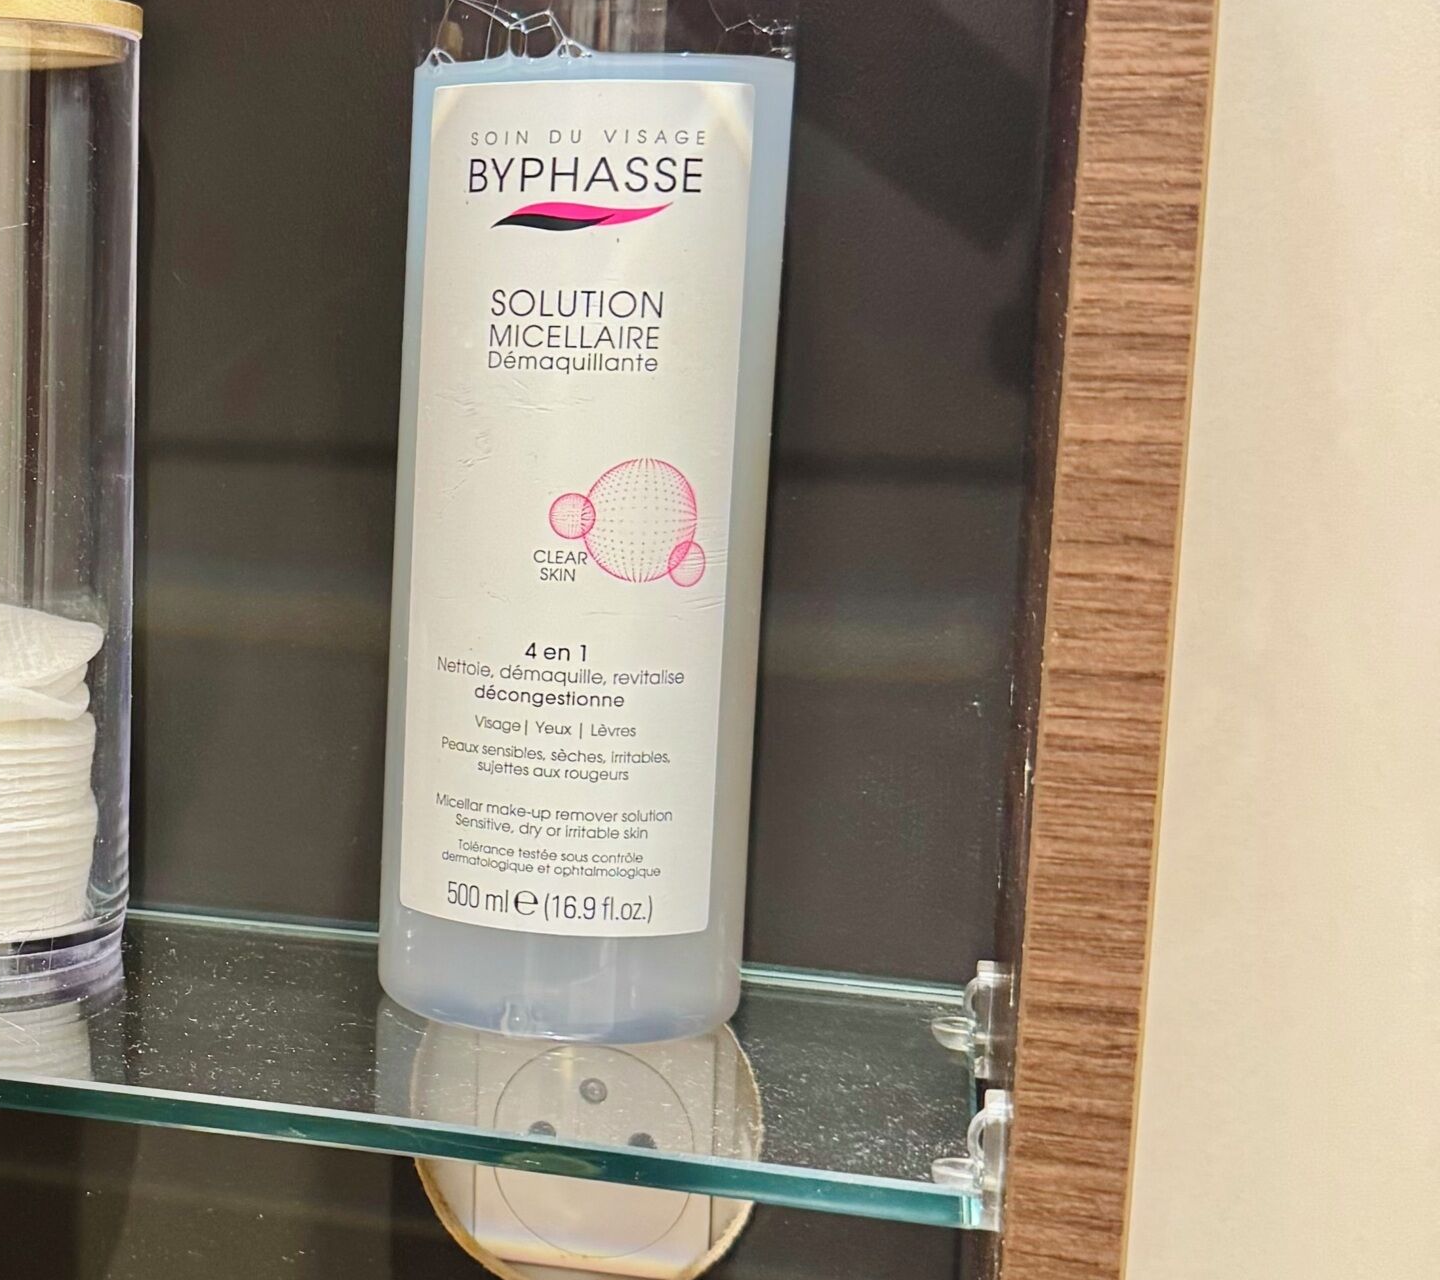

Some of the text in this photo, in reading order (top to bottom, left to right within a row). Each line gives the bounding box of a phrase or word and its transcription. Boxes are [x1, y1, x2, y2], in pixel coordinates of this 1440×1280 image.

[470, 129, 707, 146] SOIN DU VISAGE
[468, 156, 704, 193] BYPHASSE
[490, 289, 665, 319] SOLUTION
[489, 324, 660, 350] MICELLAIRE
[487, 351, 659, 375] Démaquillante
[533, 549, 588, 565] CLEAR
[540, 567, 576, 582] SKIN
[525, 642, 588, 662] 4 en 1
[437, 656, 685, 686] Nettoie, démaquille, revitalise
[474, 685, 625, 707] décongestionne
[536, 721, 572, 736] Yeux
[591, 723, 637, 738] Lèvres
[441, 737, 670, 764] Peaux sensibles, sèches, irritables,
[477, 760, 629, 783] sujettes aux rougeurs
[436, 793, 673, 822] Micellar make-up remover solution
[455, 814, 648, 840] Sensitive, dry or irritable skin
[458, 839, 644, 864] Tolérance testée sous contrôle
[441, 850, 661, 879] dermatologique et ophtalmologique
[447, 881, 479, 908] 500
[485, 889, 509, 913] ml
[544, 893, 596, 920] (16.9
